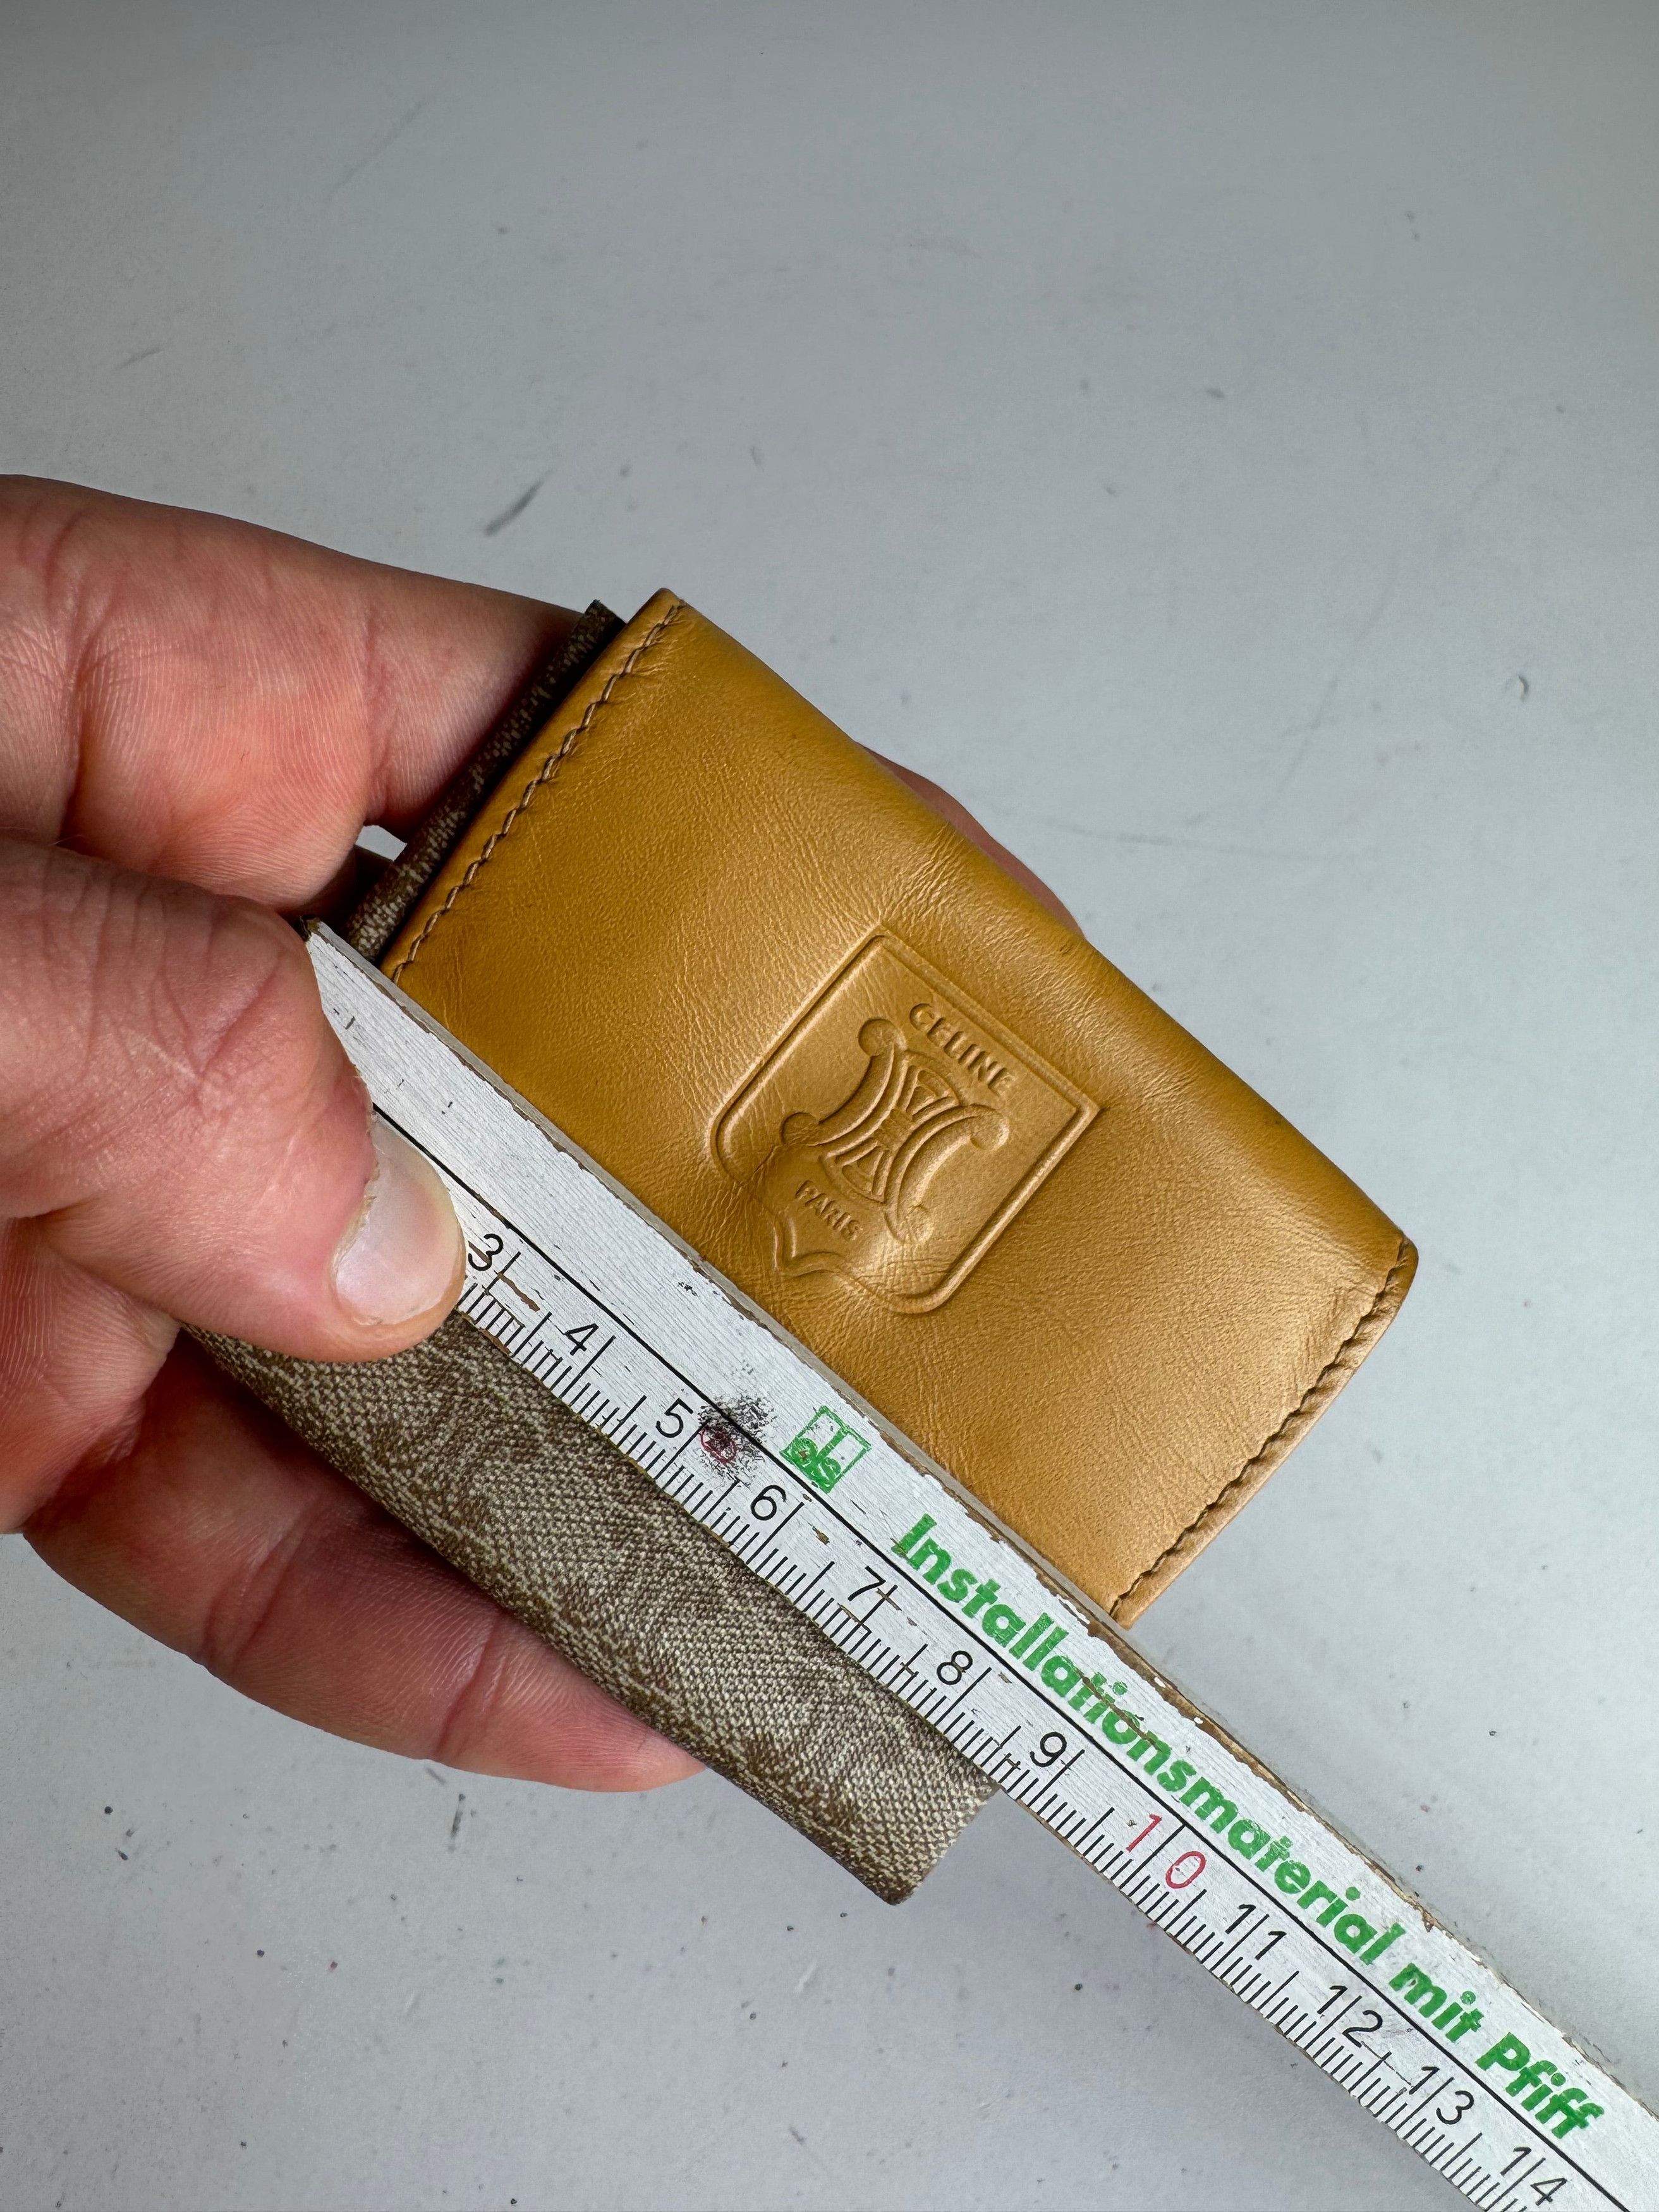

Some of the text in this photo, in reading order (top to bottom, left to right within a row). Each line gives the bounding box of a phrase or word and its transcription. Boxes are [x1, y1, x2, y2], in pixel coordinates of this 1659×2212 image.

[795, 1180, 863, 1241] PARIS
[909, 1003, 1015, 1098] CELINE
[468, 1234, 1567, 2206] 3 4 5 6 7 8 9 10 11 12 13 14
[891, 1514, 1604, 2139] Installationsmaterial mit Pfiff
